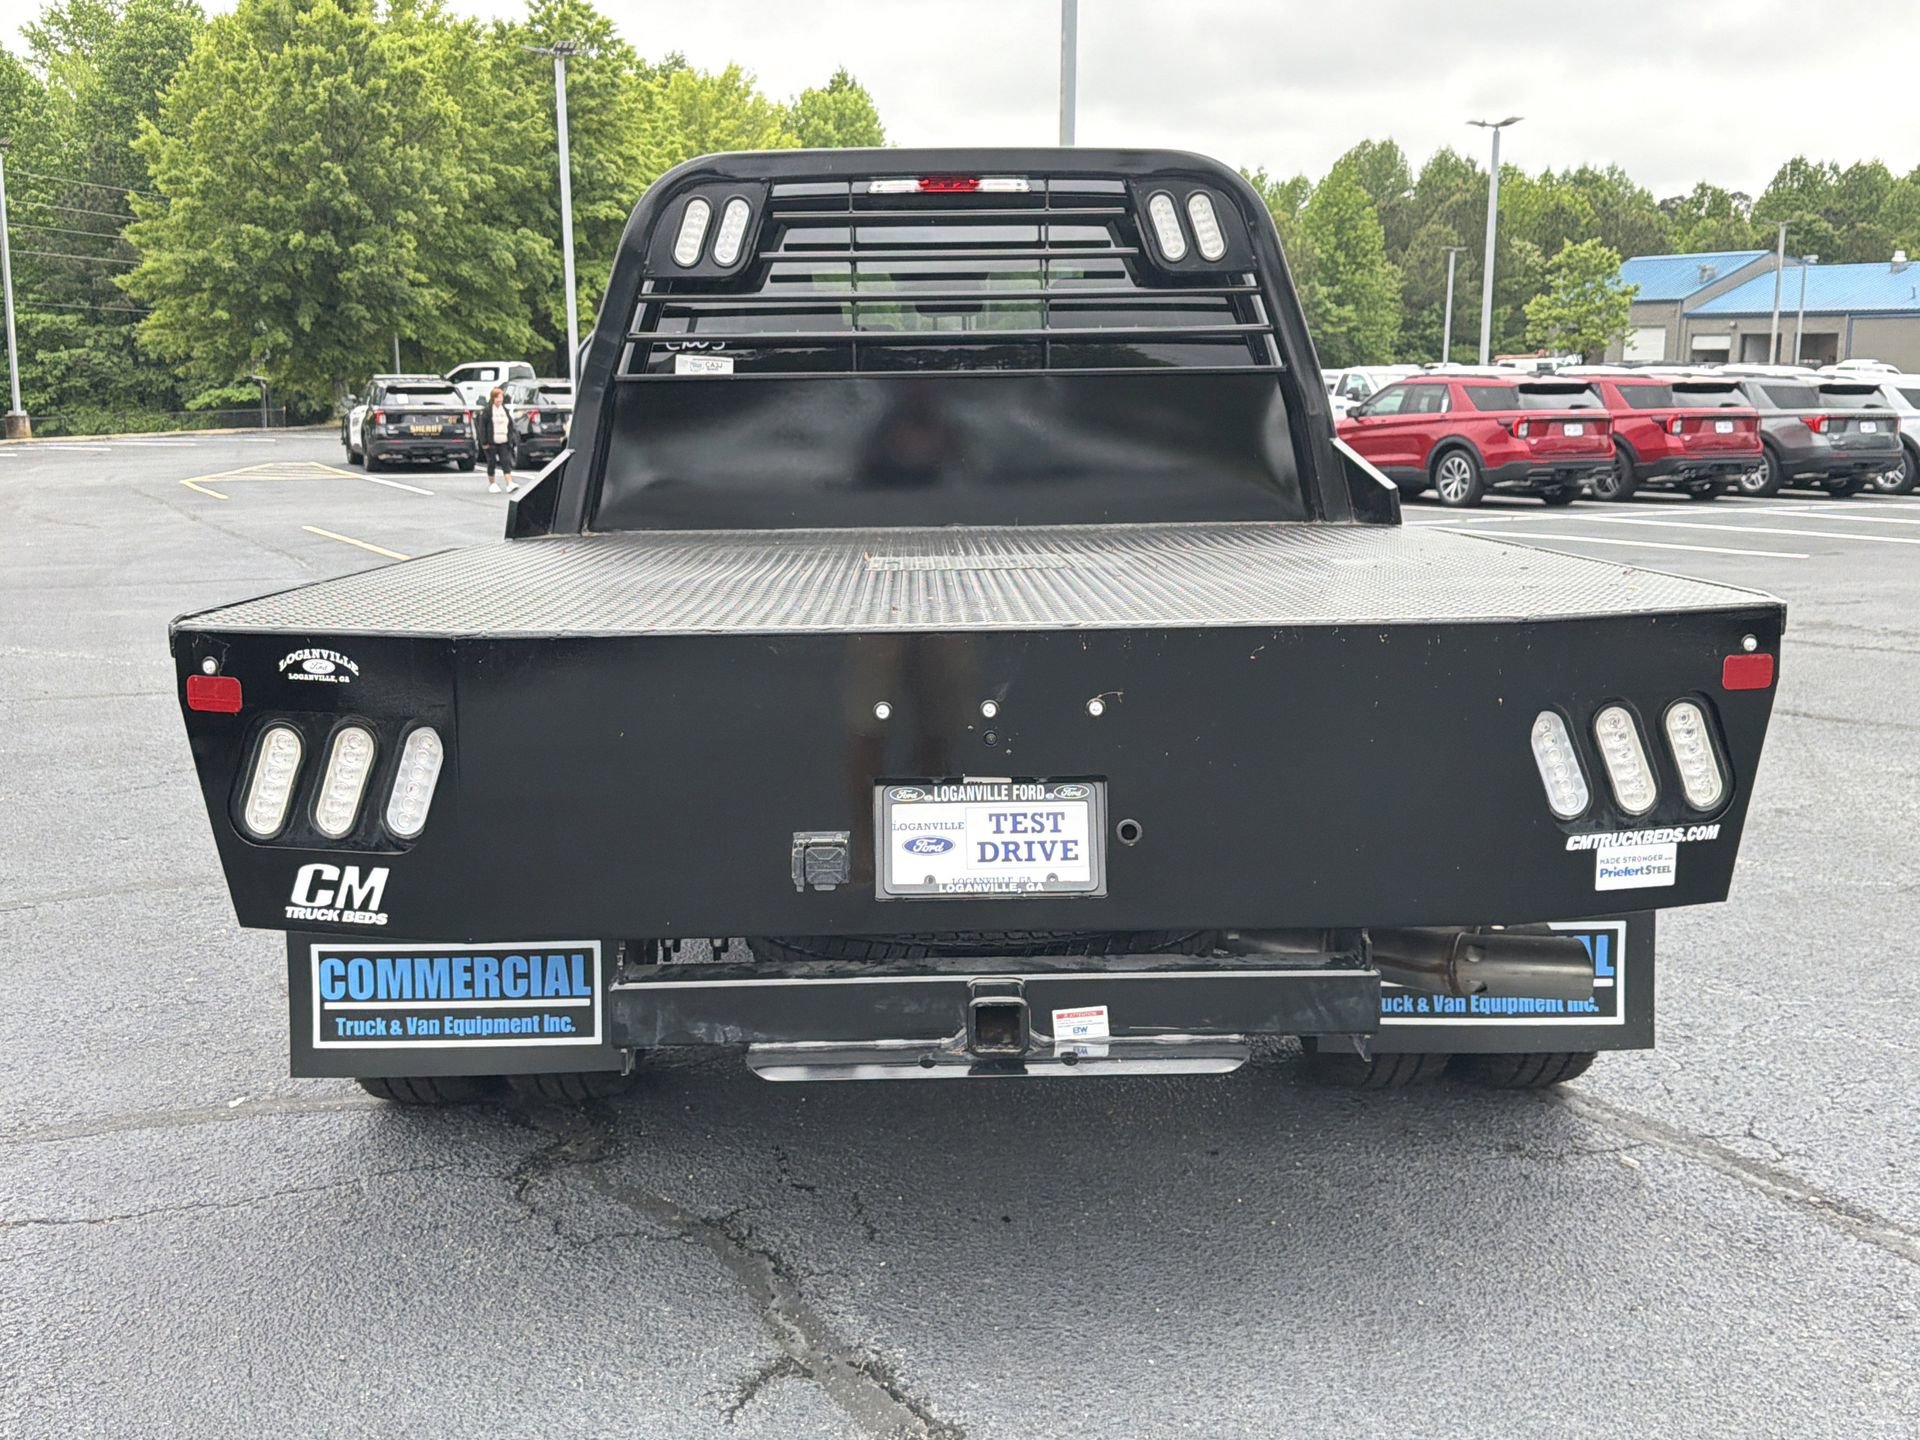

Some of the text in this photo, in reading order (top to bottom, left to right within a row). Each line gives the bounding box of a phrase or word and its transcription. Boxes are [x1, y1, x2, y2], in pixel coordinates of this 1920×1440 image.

[278, 648, 359, 676] LOGANVILLE
[288, 673, 338, 683] LOGANVILLE,
[933, 784, 1008, 801] LOGANVILLE
[1013, 784, 1045, 801] FORD
[892, 821, 965, 832] LOGANVILLE
[988, 812, 1065, 834] TEST
[912, 838, 945, 853] Ford
[1566, 824, 1720, 851] CMTRUCKBEDS.COM
[977, 840, 1079, 863] DRIVE
[1600, 857, 1620, 865] MADE
[1622, 854, 1663, 864] STRONGER
[291, 863, 390, 911] CM
[938, 882, 1044, 893] LOGANVILLE, GA
[285, 906, 388, 925] TRUCK BEDS
[319, 954, 592, 1000] COMMERCIAL
[1381, 995, 1414, 1013] uck
[1417, 997, 1430, 1013] &
[1433, 995, 1466, 1013] Van
[1470, 995, 1564, 1014] Equipment
[336, 1014, 577, 1036] Truck & Van Equipment Inc.
